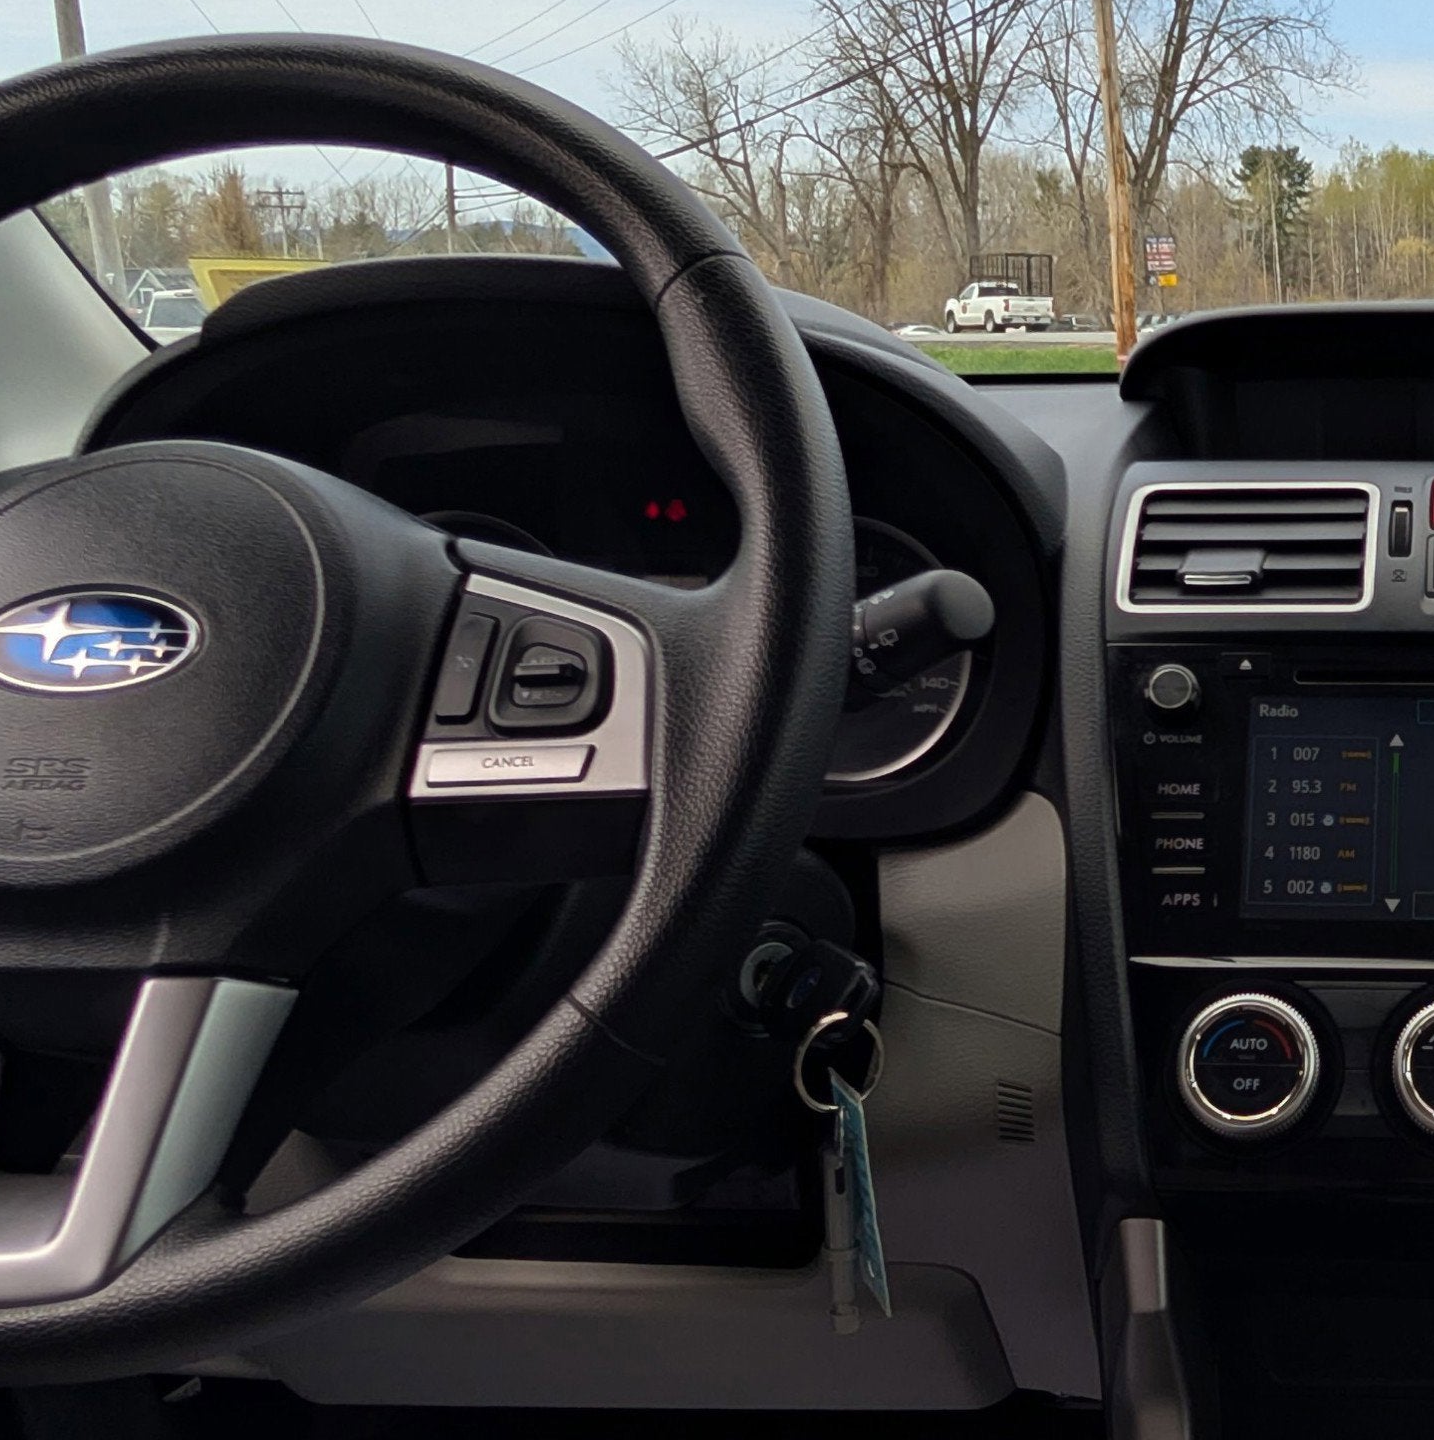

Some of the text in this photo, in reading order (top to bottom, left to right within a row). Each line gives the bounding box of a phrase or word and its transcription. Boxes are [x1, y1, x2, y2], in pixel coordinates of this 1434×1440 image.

[1259, 704, 1298, 718] Radio
[1159, 734, 1202, 744] VOLUME
[1270, 747, 1320, 761] 1 007
[482, 756, 534, 769] CANCEL
[1157, 783, 1201, 795] HOME
[1268, 780, 1277, 793] 2
[1292, 780, 1322, 794] 95.3
[1266, 813, 1315, 826] 3 015
[1155, 838, 1204, 850] PHONE
[1265, 846, 1275, 860] 4
[1289, 846, 1320, 860] 1180
[1263, 880, 1314, 894] 5 002
[1161, 893, 1201, 906] APPS
[1229, 1037, 1268, 1051] AUTO
[1233, 1077, 1261, 1091] OFF
